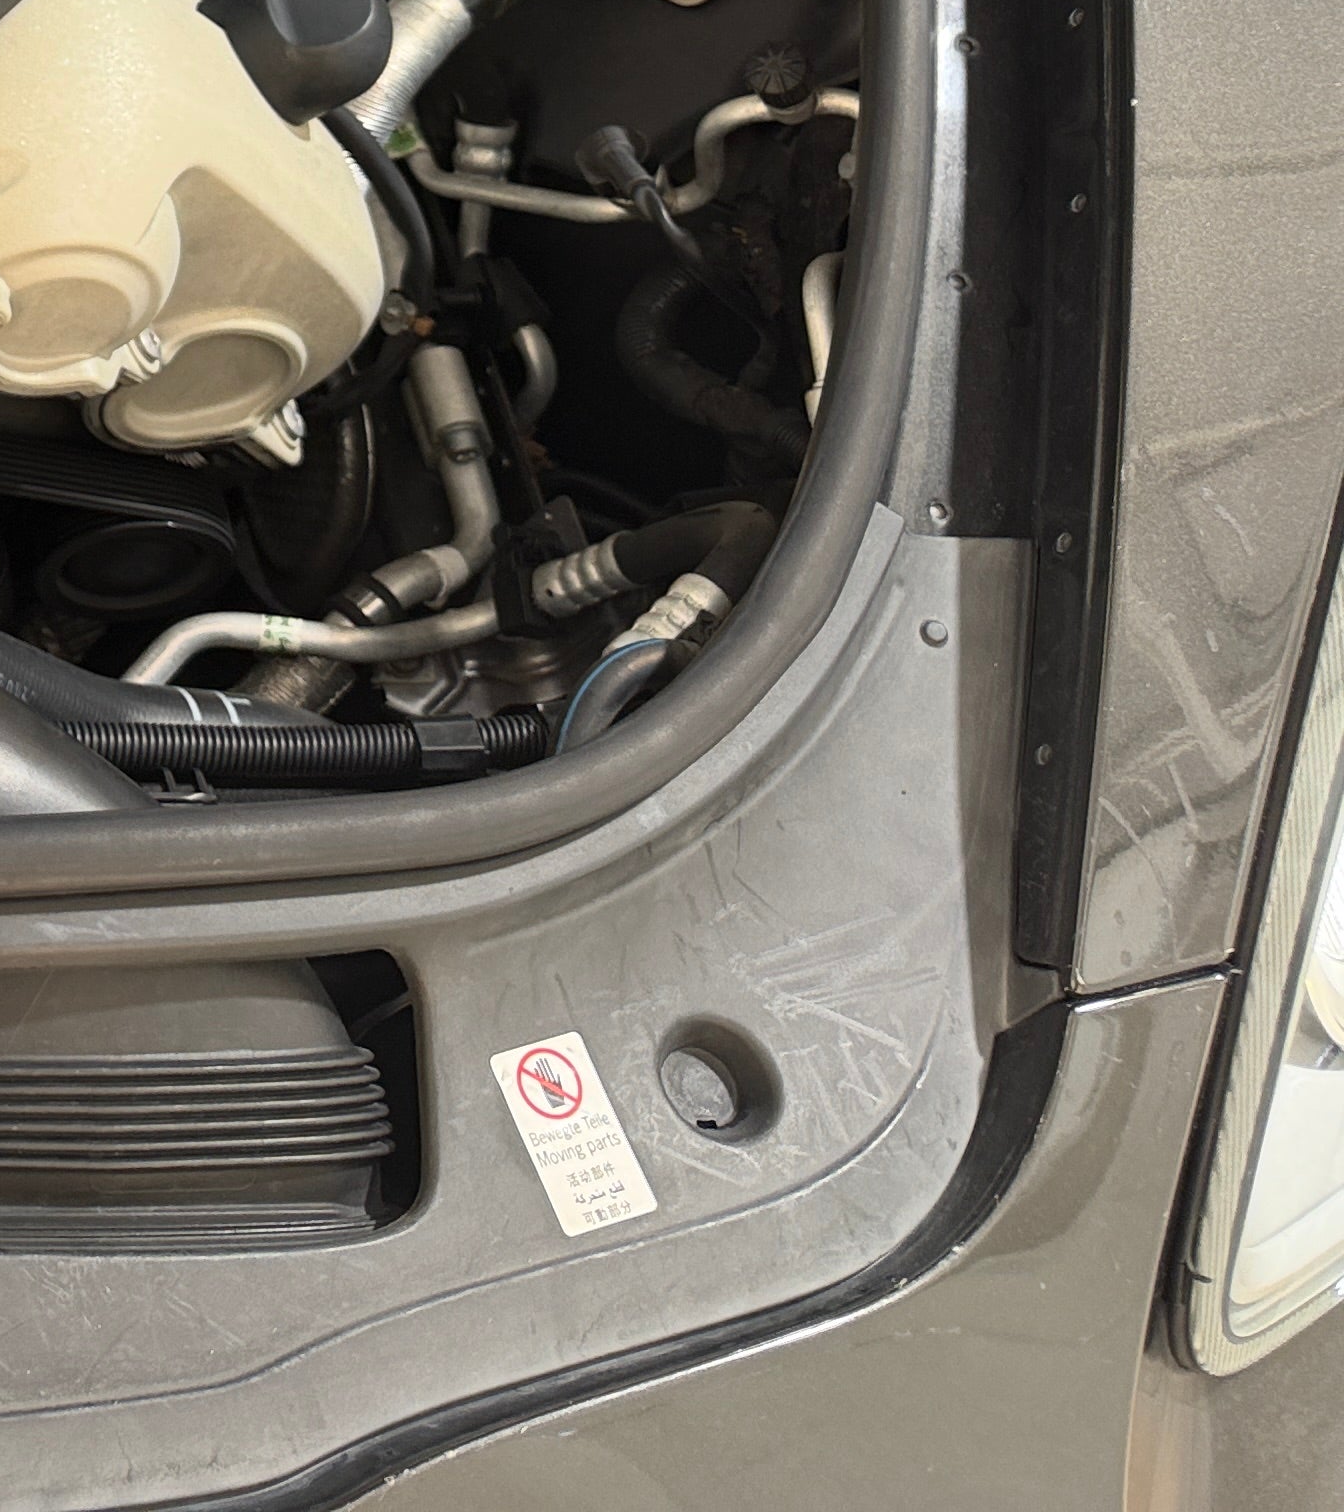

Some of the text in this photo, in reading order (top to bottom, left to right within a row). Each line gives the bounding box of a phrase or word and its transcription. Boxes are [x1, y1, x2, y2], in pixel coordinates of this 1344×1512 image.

[528, 1112, 610, 1148] Bewegte Teile
[536, 1133, 621, 1169] Moving parts
